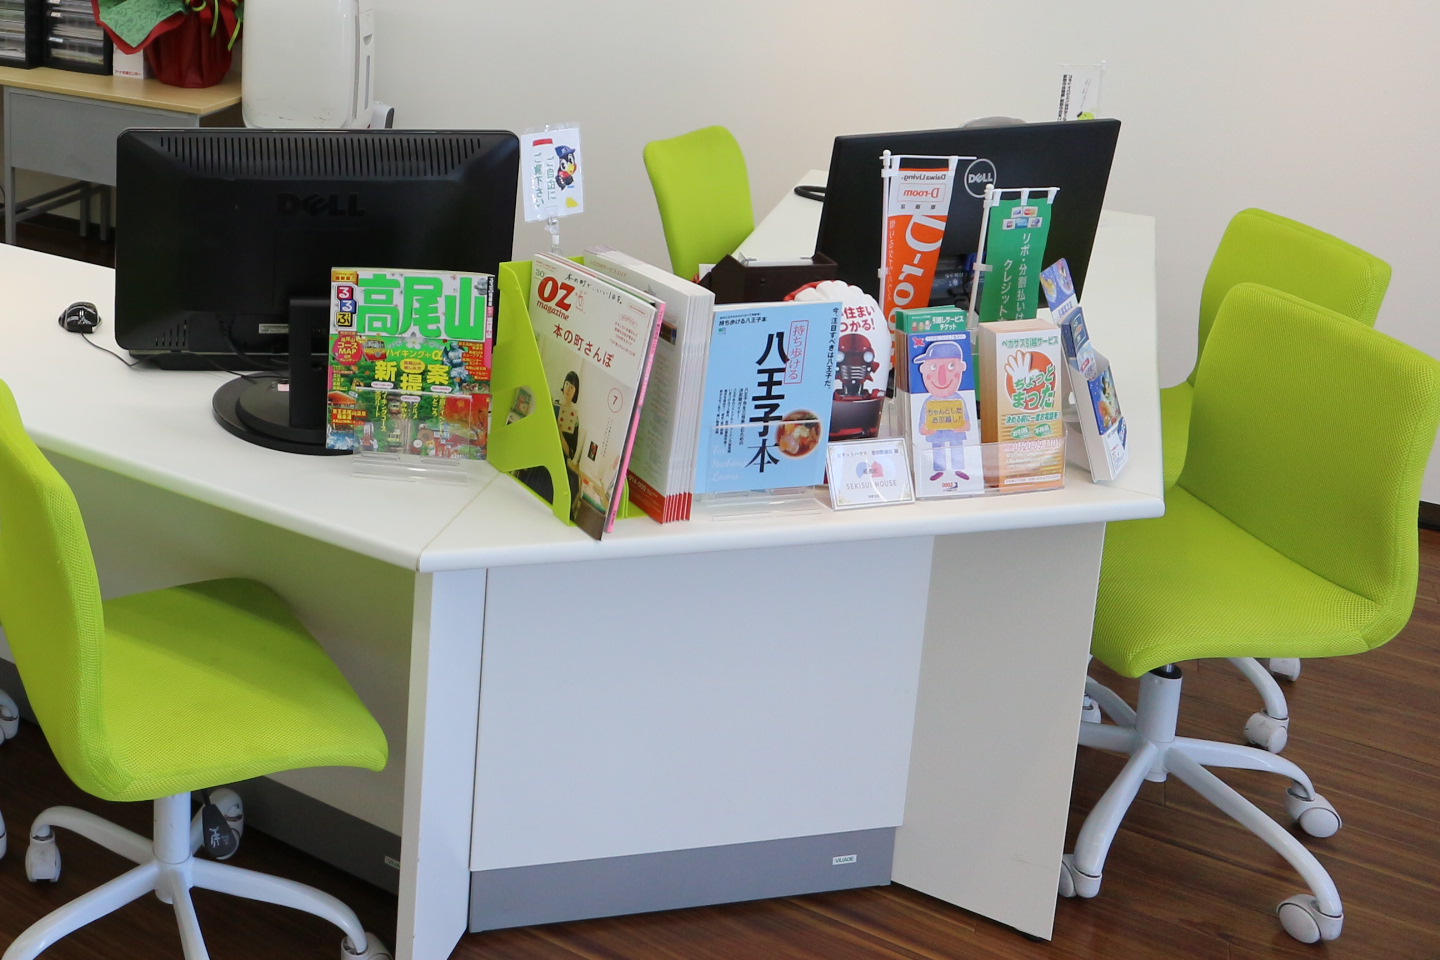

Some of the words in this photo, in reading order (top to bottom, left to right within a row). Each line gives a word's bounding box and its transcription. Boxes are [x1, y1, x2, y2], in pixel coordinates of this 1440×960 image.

[968, 172, 993, 184] DELL
[337, 287, 353, 324] るるぶ
[356, 273, 486, 341] 高尾山
[537, 276, 576, 312] OZ
[997, 259, 1013, 321] クレジット
[536, 300, 570, 321] magazine
[841, 306, 875, 319] 住まい
[553, 323, 615, 368] 本の町さんぽ
[788, 324, 805, 380] 持ち歩ける
[1014, 364, 1056, 391] ちょっと
[744, 331, 790, 473] 八王子本
[1012, 384, 1056, 409] まった
